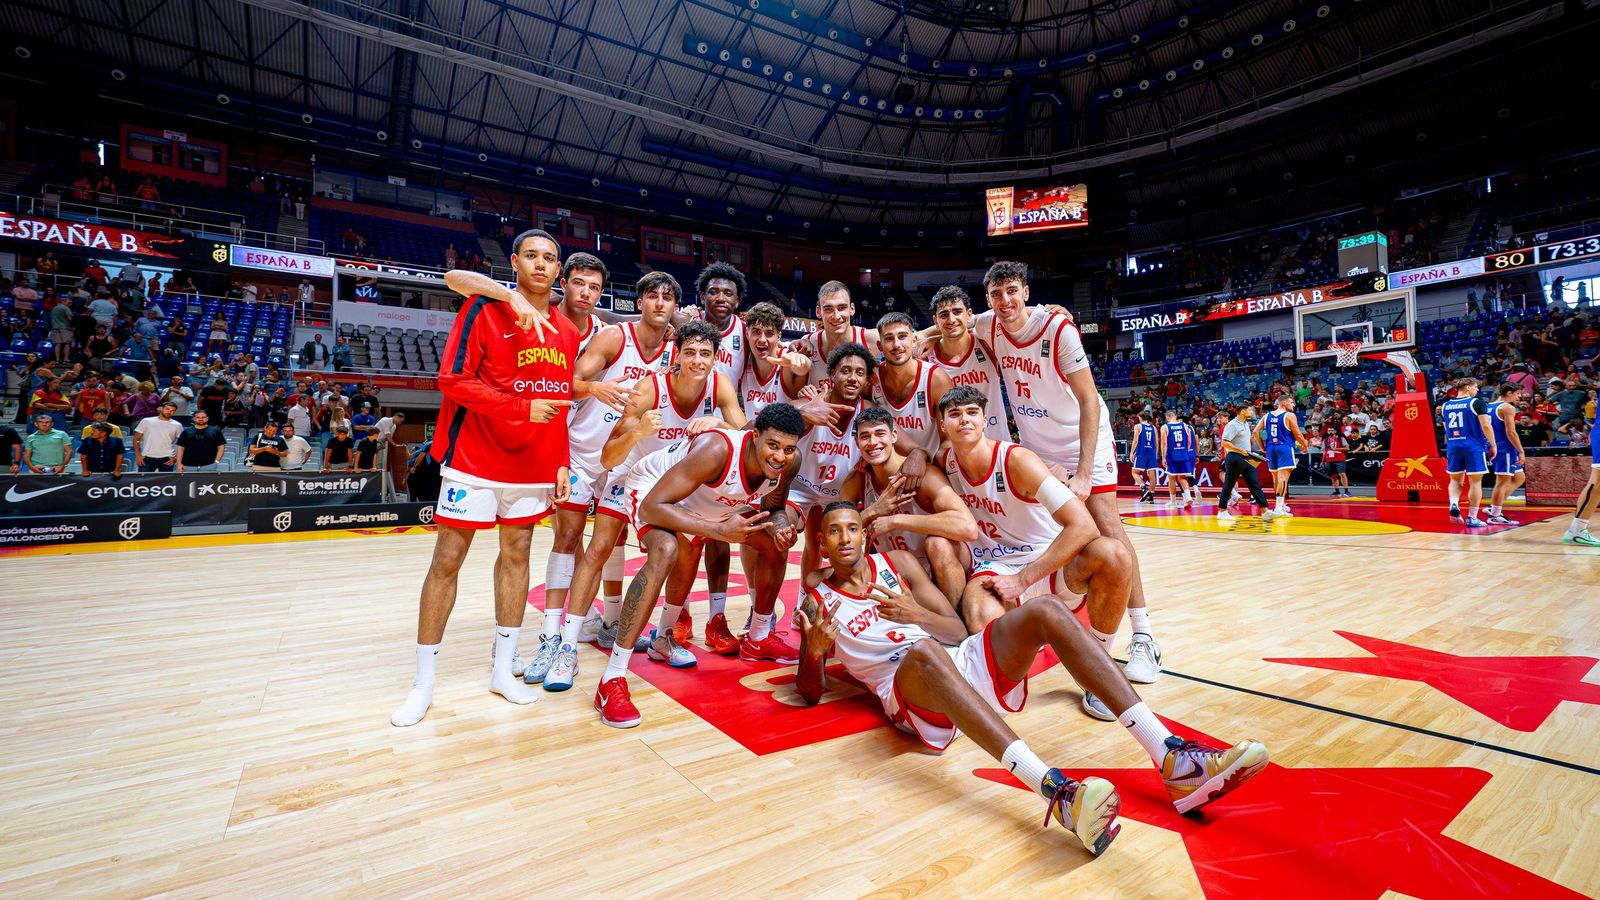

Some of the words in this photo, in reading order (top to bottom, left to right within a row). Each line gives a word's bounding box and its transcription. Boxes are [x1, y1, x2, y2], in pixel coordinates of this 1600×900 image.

[1019, 207, 1069, 224] ESPAÑA
[1072, 206, 1082, 219] B
[0, 216, 112, 250] ESPAÑA
[120, 233, 138, 252] B
[1340, 234, 1375, 249] 73:39
[246, 253, 298, 269] ESPAÑA
[303, 260, 312, 270] B
[1495, 253, 1524, 268] 80
[1401, 269, 1447, 284] ESPAÑA
[1452, 266, 1460, 275] B
[1247, 292, 1307, 314] ESPAÑA
[1312, 290, 1323, 303] B
[783, 318, 807, 332] AÑA
[810, 322, 817, 332] B
[1121, 314, 1172, 331] ESPAÑA
[1176, 312, 1185, 325] B
[517, 347, 567, 369] ESPAÑA
[514, 377, 569, 393] endesa
[1015, 380, 1031, 399] 15
[1448, 411, 1464, 428] 21
[1173, 430, 1183, 442] 15
[1271, 424, 1277, 437] 5
[819, 465, 837, 481] 13
[87, 483, 176, 498] endesa
[217, 483, 279, 495] CaixaBank
[1387, 481, 1442, 490] CaixaBank
[315, 512, 398, 526] #LaFamilia
[30, 525, 89, 534] ESPAÑOLA
[977, 520, 1002, 538] 12
[0, 533, 74, 542] BALONCESTO
